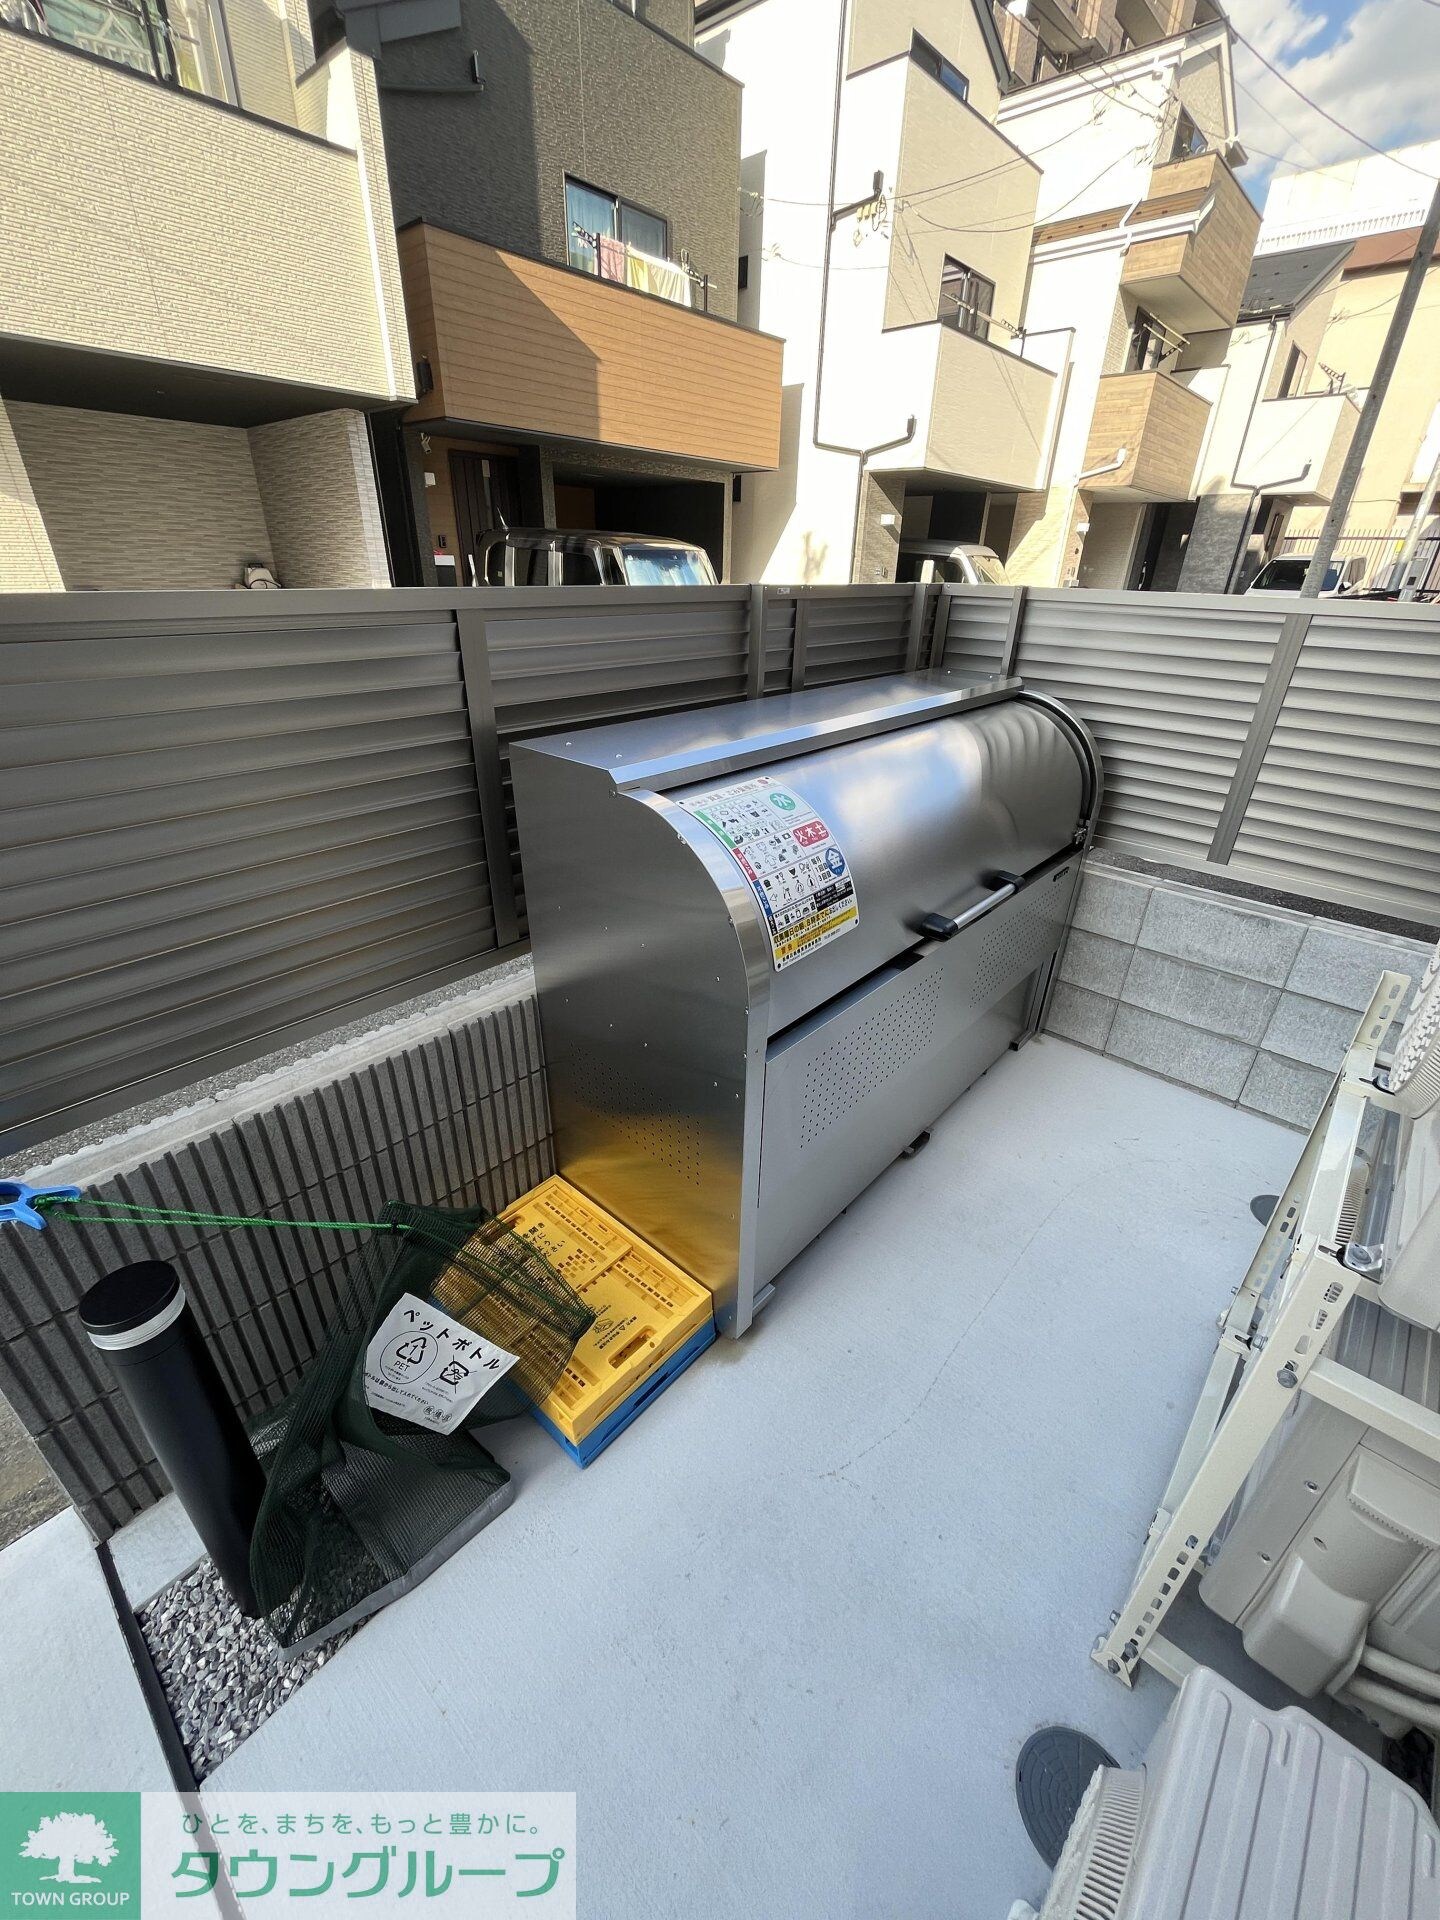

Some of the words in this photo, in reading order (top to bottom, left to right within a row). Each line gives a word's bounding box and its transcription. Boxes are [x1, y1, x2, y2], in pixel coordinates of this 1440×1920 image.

[771, 794, 792, 807] 水
[828, 850, 843, 869] 金
[403, 1309, 500, 1370] ペットボトル
[393, 1360, 411, 1372] PET
